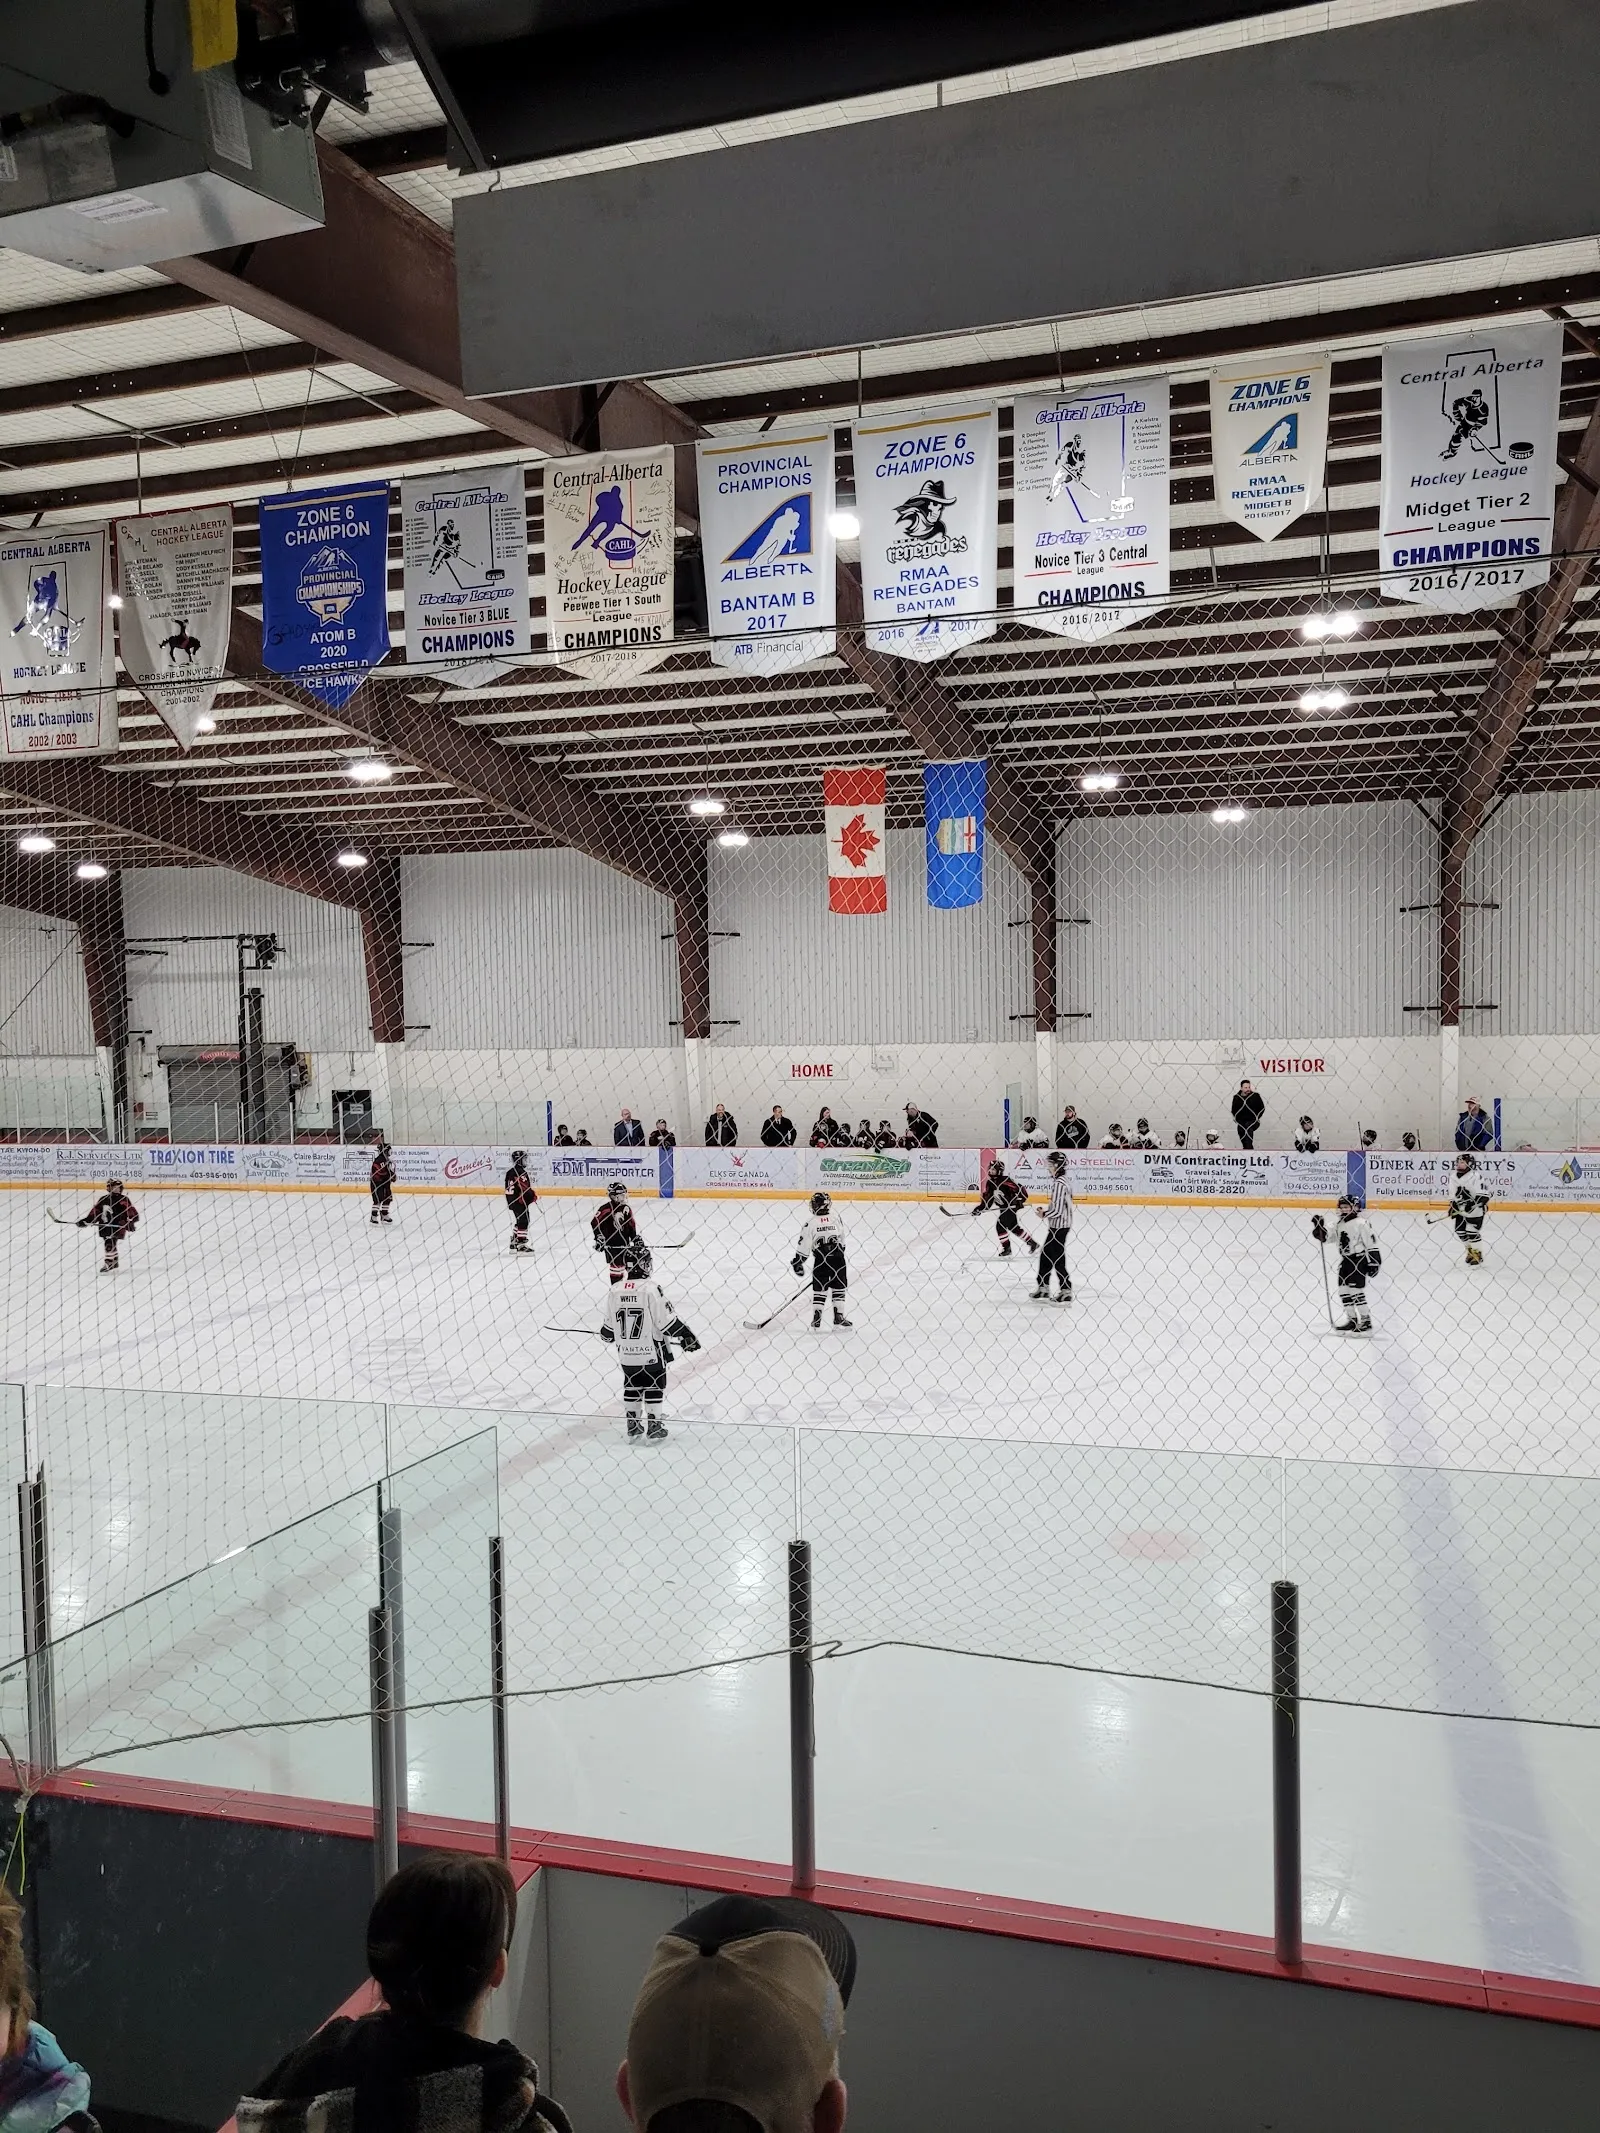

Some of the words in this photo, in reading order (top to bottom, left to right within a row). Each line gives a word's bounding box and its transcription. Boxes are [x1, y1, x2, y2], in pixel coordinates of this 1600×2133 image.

[1400, 366, 1466, 386] Central
[1473, 357, 1544, 376] Alberta
[1230, 379, 1291, 400] ZONE
[1295, 375, 1311, 391] 6
[1228, 392, 1312, 412] CHAMPIONS
[1036, 406, 1089, 425] Central
[1091, 401, 1146, 419] Alberta
[884, 435, 948, 460] ZONE
[954, 432, 967, 449] 6
[1238, 454, 1298, 468] ALBERTA
[1509, 451, 1533, 460] CAHL
[718, 455, 813, 478] PROVINCIAL
[875, 451, 975, 478] CHAMPIONS
[553, 465, 606, 489] Central
[609, 463, 663, 483] Alberta
[718, 472, 812, 494] CHAMPIONS
[1249, 475, 1287, 487] RMAA
[1410, 472, 1466, 488] Hockey
[1472, 465, 1528, 482] League
[1232, 484, 1305, 499] RENEGADES
[415, 497, 461, 513] Central
[463, 493, 509, 507] Alberta
[1244, 500, 1283, 511] MIDGET
[1406, 500, 1470, 518] Midget
[1477, 495, 1514, 510] Tier
[1519, 492, 1530, 506] 2
[297, 507, 341, 527] ZONE
[345, 505, 355, 520] 6
[1244, 509, 1291, 519] 2016/2017
[151, 525, 188, 537] CENTRAL
[191, 520, 227, 531] ALBERTA
[285, 521, 370, 547] CHAMPION
[1438, 518, 1496, 533] League
[156, 535, 189, 546] HOCKEY
[192, 530, 224, 540] LEAGUE
[608, 539, 633, 550] CAHL
[1036, 529, 1090, 547] Hockey
[1, 547, 44, 561] CENTRAL
[48, 541, 91, 555] ALBERTA
[1035, 551, 1070, 569] Novice
[1074, 550, 1095, 566] Tier
[1098, 548, 1105, 563] 3
[1109, 544, 1148, 561] Central
[1393, 537, 1540, 567] CHAMPIONS
[303, 570, 355, 584] PROVINCIAL
[720, 562, 814, 583] ALBERTA
[900, 565, 950, 582] RMAA
[1077, 566, 1104, 576] League
[557, 576, 611, 595] Hockey
[615, 572, 667, 592] League
[873, 576, 979, 601] RENEGADES
[1408, 569, 1525, 593] 2016/2017
[299, 582, 361, 600] CHAMPIONSHIPS
[419, 592, 468, 606] Hockey
[471, 588, 514, 602] League
[1038, 581, 1146, 607] CHAMPIONS
[563, 598, 600, 612] Peewee
[603, 596, 622, 609] Tier
[625, 596, 630, 606] 1
[634, 593, 662, 605] South
[721, 592, 796, 614] BANTAM
[803, 592, 815, 606] B
[896, 596, 956, 614] BANTAM
[424, 614, 457, 627] Novice
[459, 611, 477, 625] Tier
[479, 611, 485, 623] 3
[488, 607, 510, 621] BLUE
[592, 611, 632, 624] League
[747, 614, 787, 631] 2017
[1062, 610, 1120, 626] 2016/2017
[878, 628, 904, 641] 2016
[951, 620, 978, 632] 2017
[310, 630, 344, 644] ATOM
[348, 629, 356, 640] B
[422, 629, 515, 654] CHAMPIONS
[564, 625, 662, 649] CHAMPIONS
[320, 645, 347, 658] 2020
[734, 643, 753, 656] ATB
[756, 641, 804, 653] Financial
[14, 665, 48, 678] HOCKEY
[51, 662, 86, 675] LEAGUE
[139, 671, 184, 681] CROSSFIELD
[303, 677, 323, 689] ICE
[326, 673, 364, 687] HAWKS
[161, 686, 204, 697] CHAMPIONS
[11, 714, 36, 728] CAHL
[39, 710, 94, 727] Champions
[29, 735, 49, 747] 2002
[56, 733, 77, 745] 2003
[791, 1064, 834, 1078] HOME
[1260, 1058, 1326, 1074] VISITOR
[77, 1150, 120, 1159] SERVICES
[150, 1149, 205, 1166] TRAXION
[209, 1151, 235, 1164] TIRE
[294, 1153, 311, 1161] Claire
[312, 1153, 336, 1162] Barclay
[1080, 1158, 1110, 1166] STEEL
[1114, 1158, 1135, 1166] INC.
[1144, 1155, 1171, 1165] DVM
[1174, 1155, 1247, 1169] Contracting
[1250, 1156, 1274, 1167] Ltd.
[444, 1155, 493, 1179] Carmen's
[1370, 1160, 1414, 1170] DINER
[1420, 1160, 1437, 1170] AT
[265, 1170, 289, 1178] Office
[1372, 1175, 1402, 1185] Great
[1405, 1175, 1434, 1185] Food!
[1171, 1186, 1195, 1194] (403)
[1197, 1186, 1245, 1194] 888-2820
[1376, 1188, 1395, 1197] Fully
[1397, 1188, 1432, 1196] Licensed
[616, 1307, 644, 1340] 17
